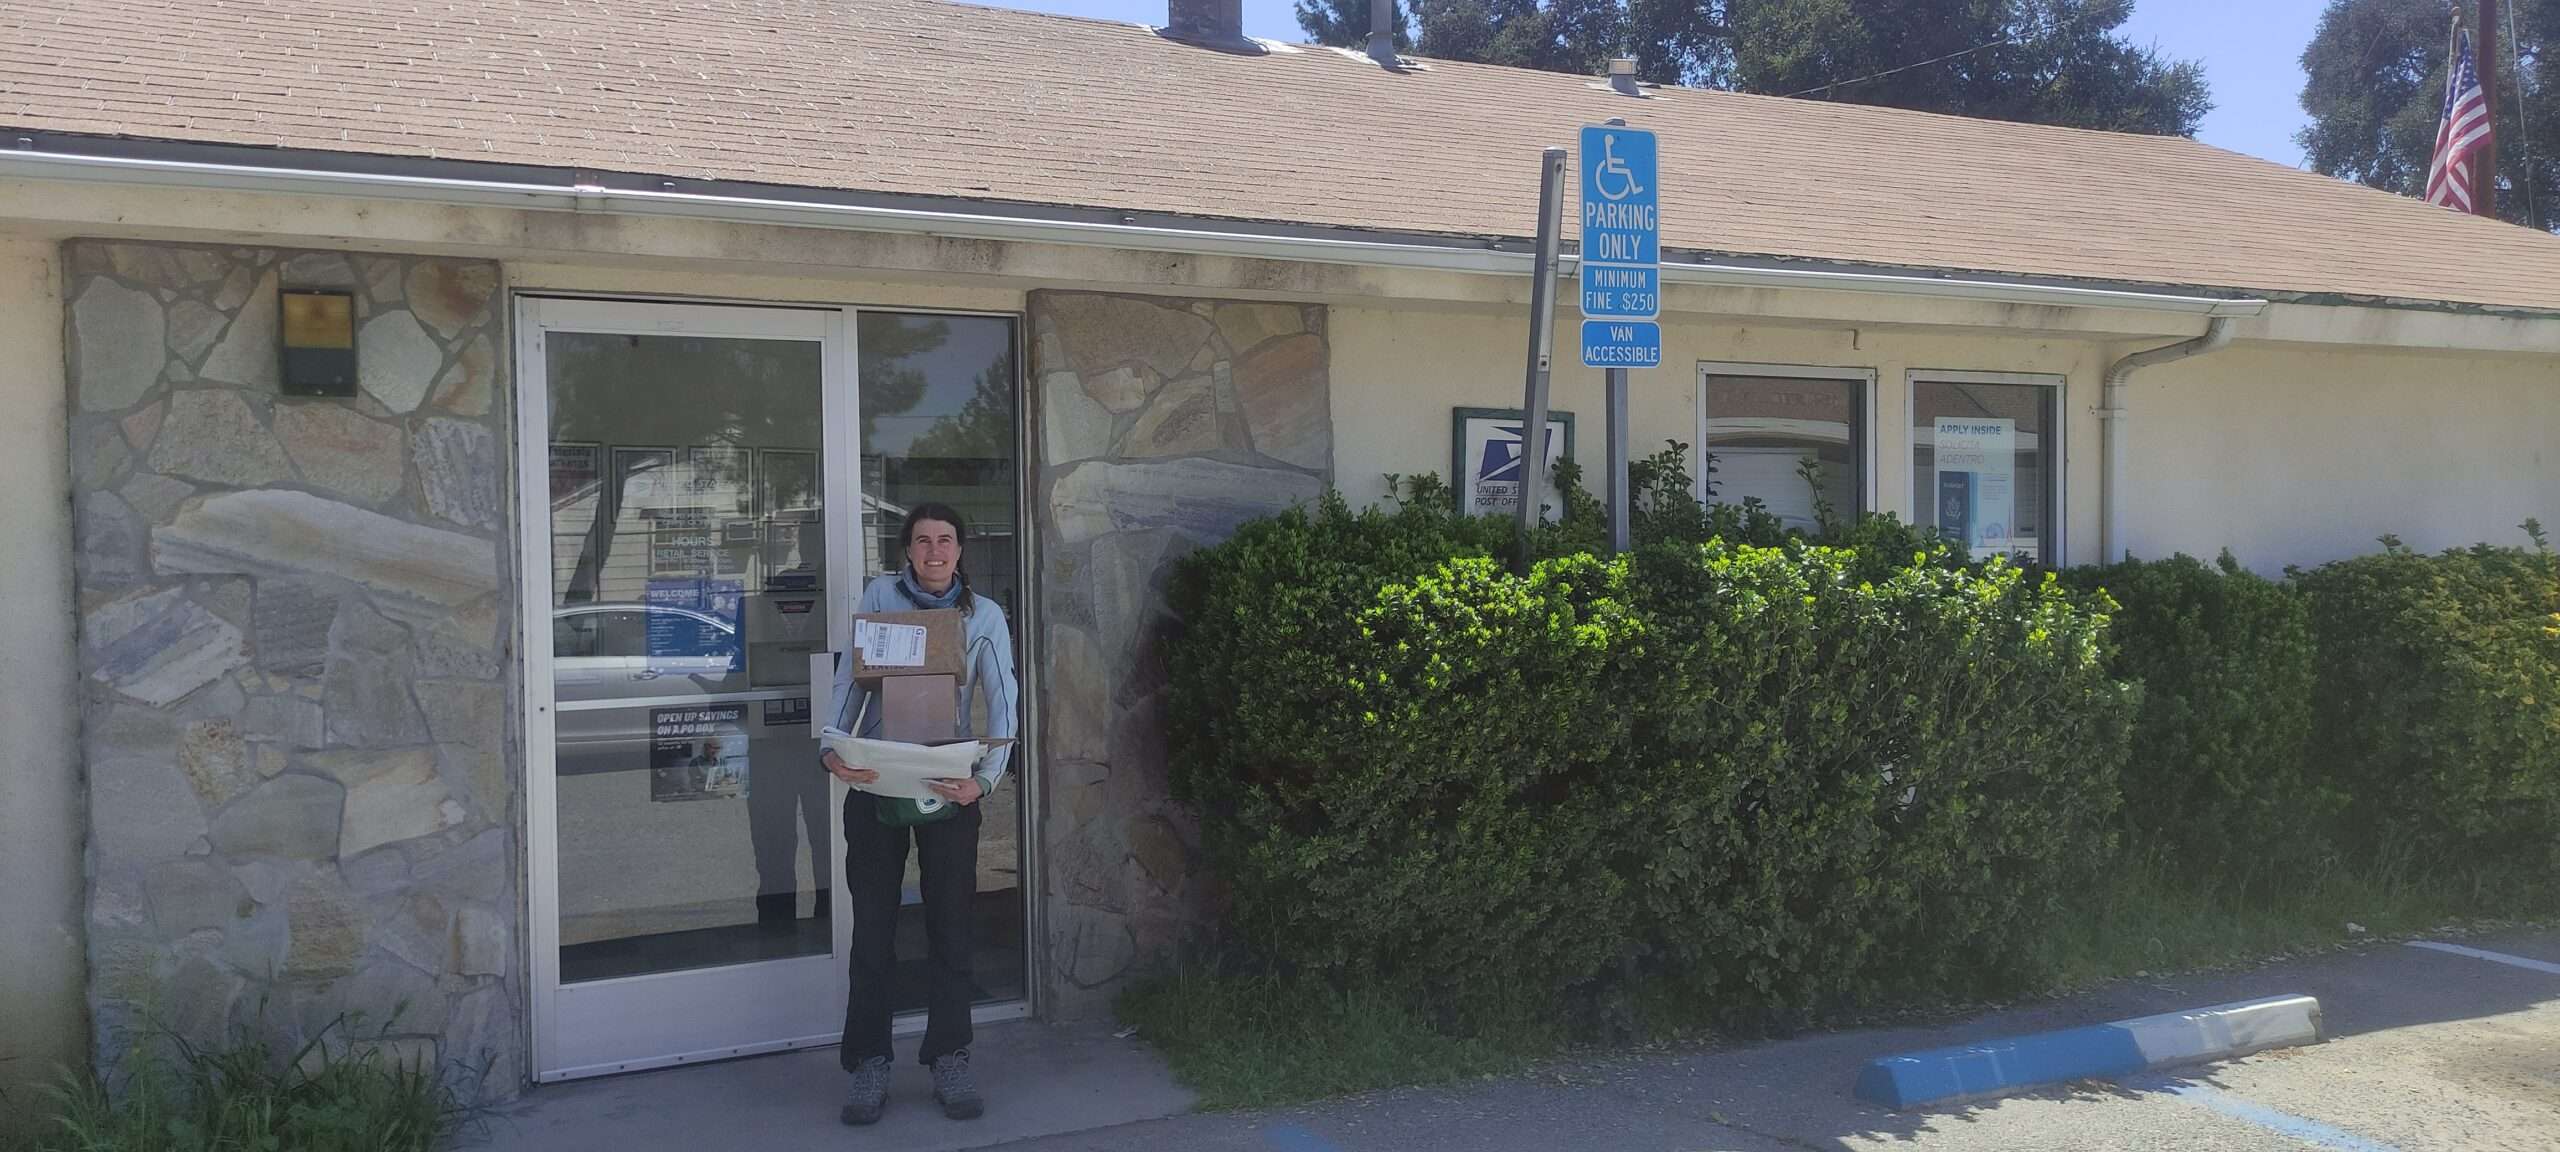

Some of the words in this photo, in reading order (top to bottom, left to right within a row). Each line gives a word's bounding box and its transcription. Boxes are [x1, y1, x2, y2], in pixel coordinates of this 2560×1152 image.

[1586, 201, 1654, 231] PARKING
[1600, 232, 1642, 260] ONLY
[1595, 269, 1646, 288] MINIMUM
[1585, 291, 1612, 310] FINE
[1622, 292, 1654, 312] $250
[1610, 325, 1633, 342] VAN
[1585, 345, 1658, 362] ACCESSIBLE
[1940, 424, 1969, 435] APPLY
[1971, 425, 2001, 435] INSIDE
[1476, 485, 1508, 494] UNITED
[1475, 497, 1498, 506] POST
[1501, 497, 1519, 506] OFF
[672, 536, 713, 546] HOURS
[656, 549, 685, 558] RETAIL
[651, 589, 699, 598] WELCOME
[657, 712, 683, 723] OPEN
[684, 712, 697, 722] UP
[698, 710, 739, 721] SAVINGS
[657, 725, 671, 735] ON
[671, 725, 680, 735] A
[680, 724, 694, 734] PO
[695, 723, 715, 733] BOX
